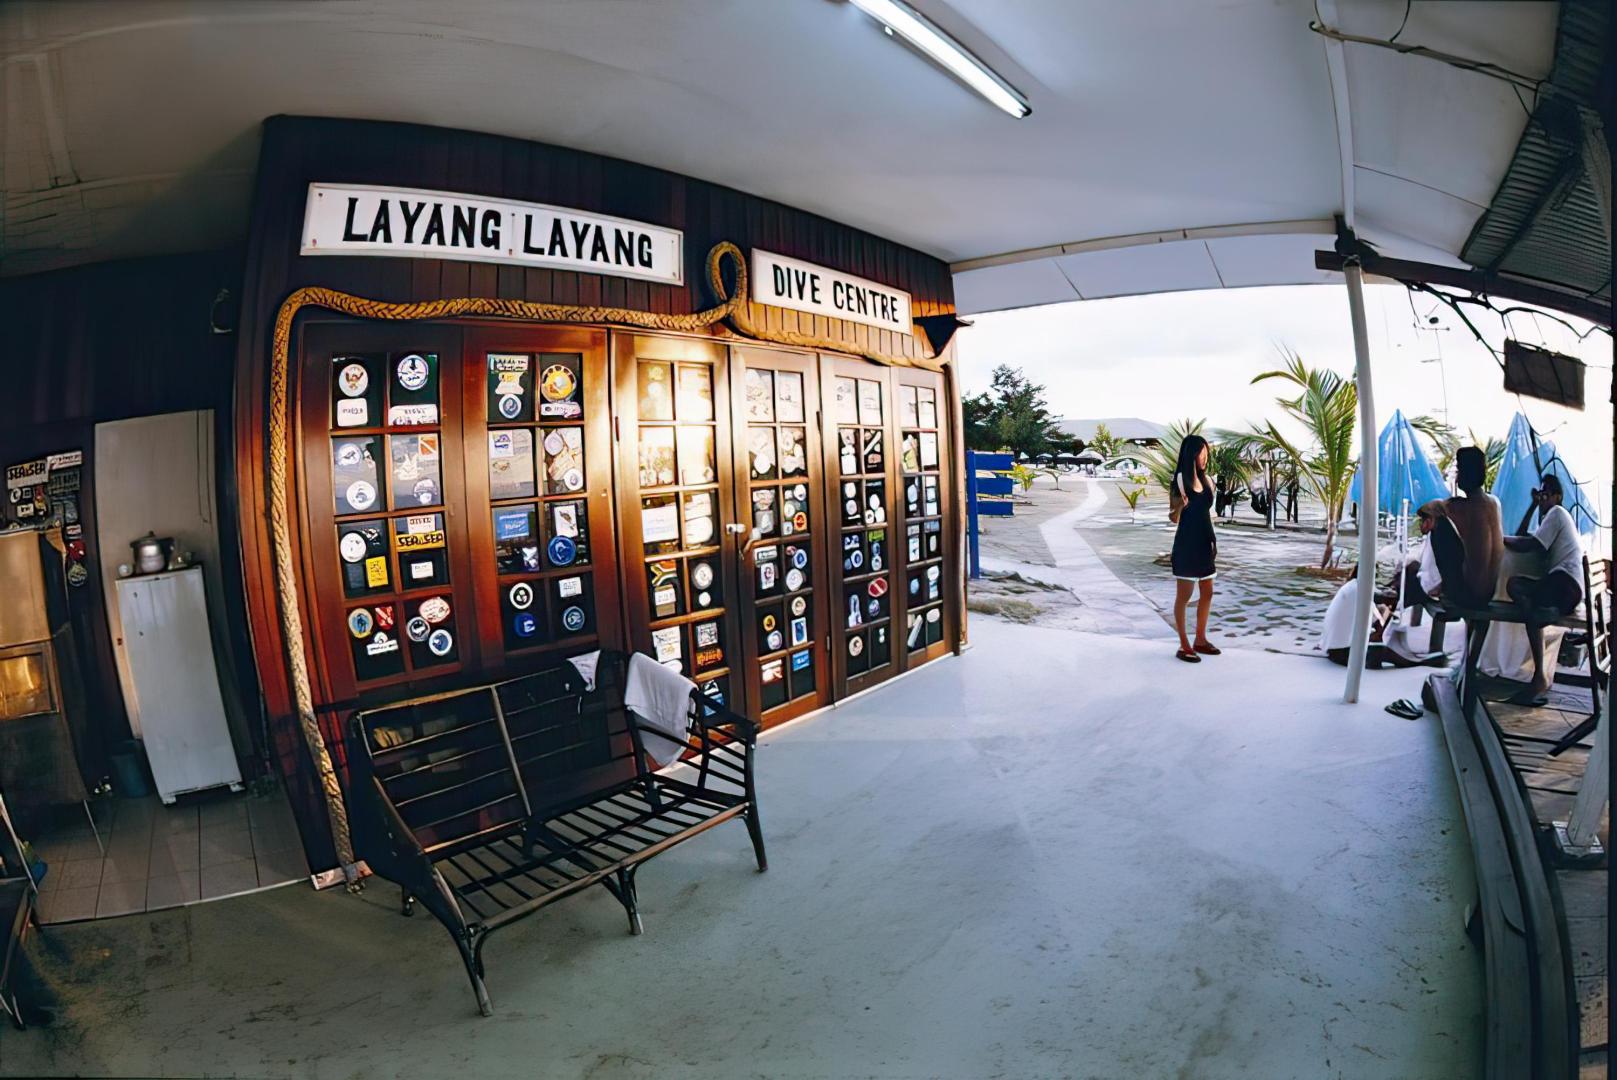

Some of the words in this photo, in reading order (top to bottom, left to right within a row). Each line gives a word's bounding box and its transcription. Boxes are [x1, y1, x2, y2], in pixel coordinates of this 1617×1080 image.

[342, 197, 501, 250] LAYANG
[523, 214, 653, 269] LAYANG
[772, 264, 822, 304] DIVE
[833, 280, 900, 324] CENTRE
